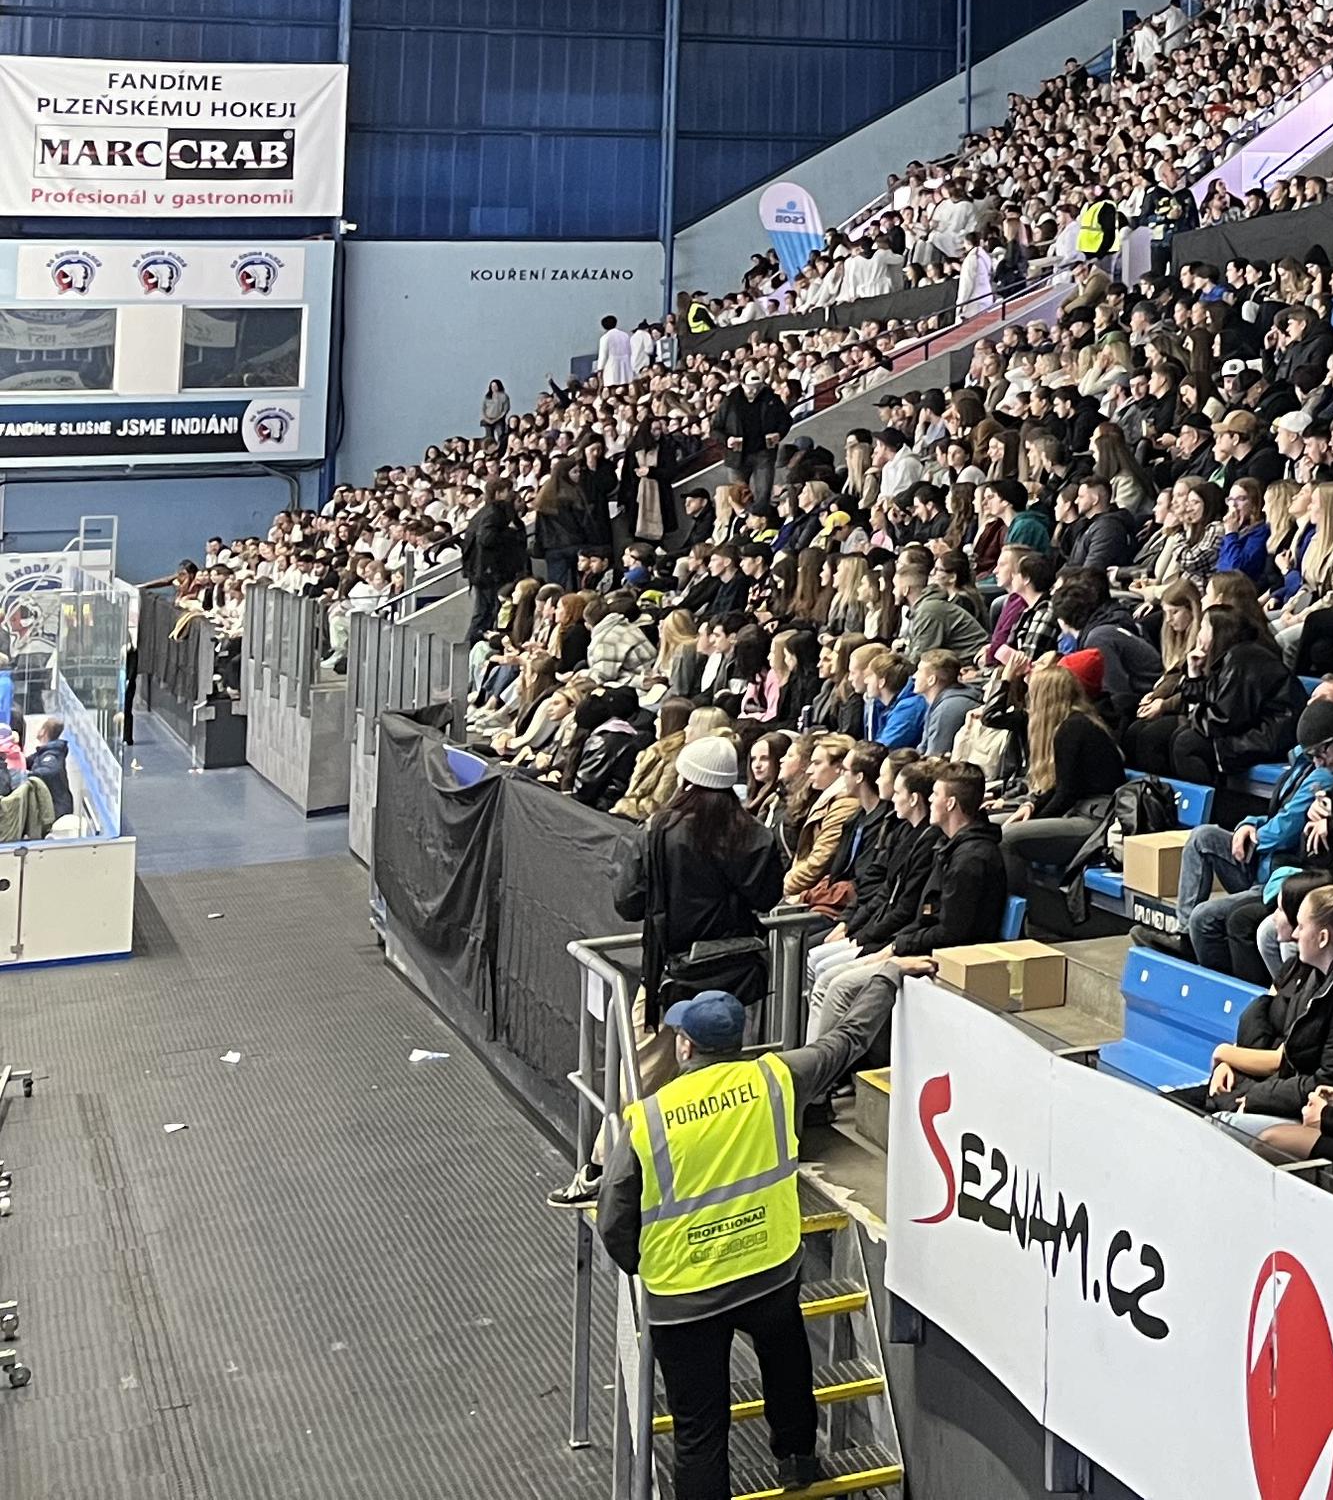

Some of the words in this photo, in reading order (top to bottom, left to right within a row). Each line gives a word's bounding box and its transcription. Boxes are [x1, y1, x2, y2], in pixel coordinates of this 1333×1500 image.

[108, 69, 222, 91] FANDÍME
[36, 94, 201, 117] PLZEŇSKÉMU
[210, 101, 296, 118] HOKEJI
[39, 138, 163, 167] MARC
[168, 139, 288, 170] CRAB
[31, 188, 147, 204] Profesionál
[154, 192, 165, 204] v
[172, 189, 294, 209] gastronomii
[470, 267, 546, 281] KOUŘENÍ
[550, 267, 634, 281] ZAKÁZÁNO
[116, 417, 166, 437] JSME
[171, 413, 239, 436] INDIÁNI
[664, 1082, 760, 1130] POŘADATEL
